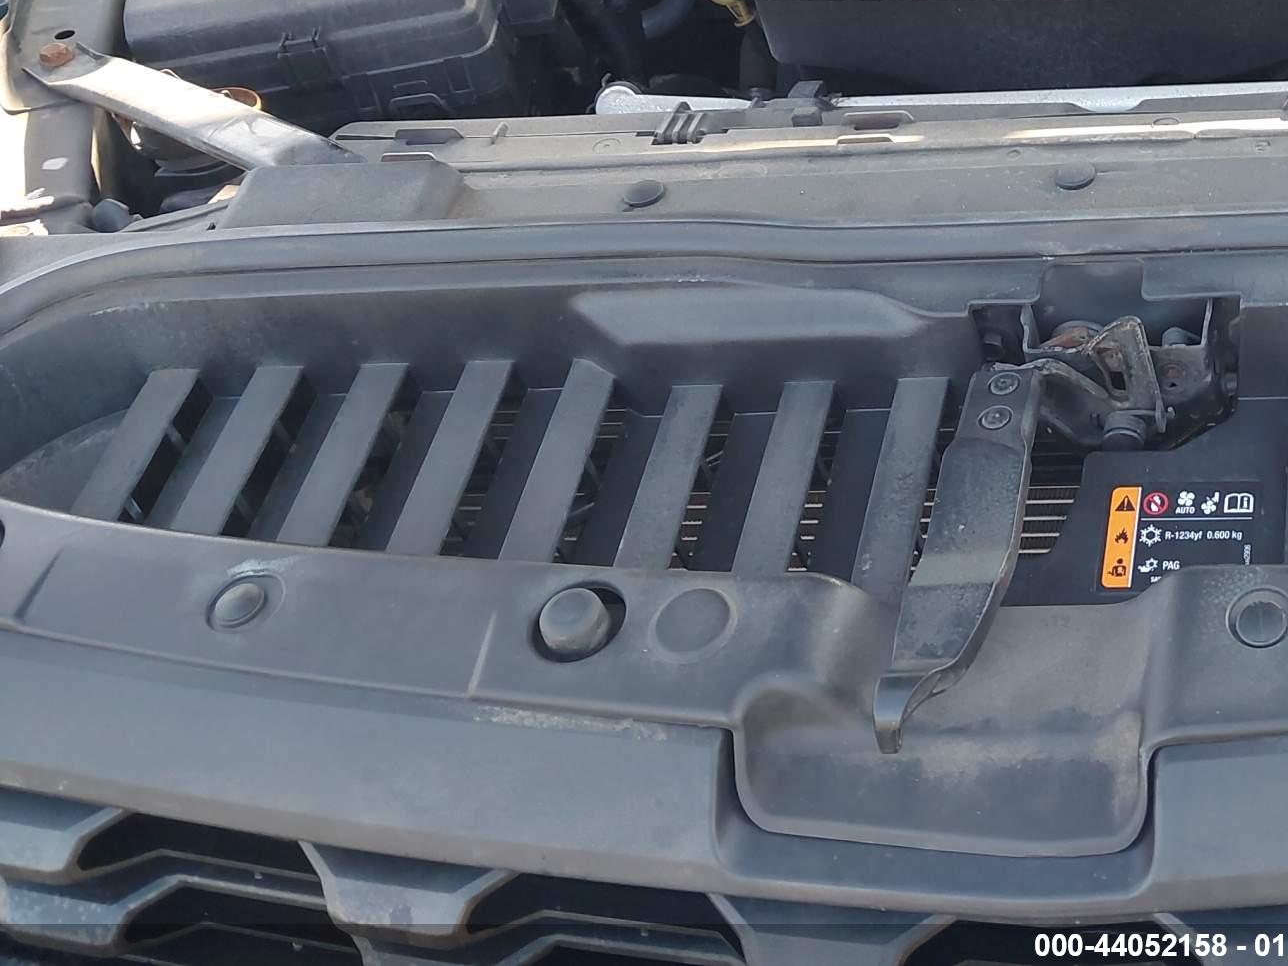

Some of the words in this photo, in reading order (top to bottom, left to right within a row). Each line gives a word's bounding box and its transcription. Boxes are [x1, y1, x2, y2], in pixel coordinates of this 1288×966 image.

[1175, 506, 1196, 514] AUTO
[1164, 530, 1203, 541] R-1234yf
[1207, 530, 1230, 540] 0.600
[1232, 530, 1243, 541] kg
[1162, 560, 1181, 571] PAG
